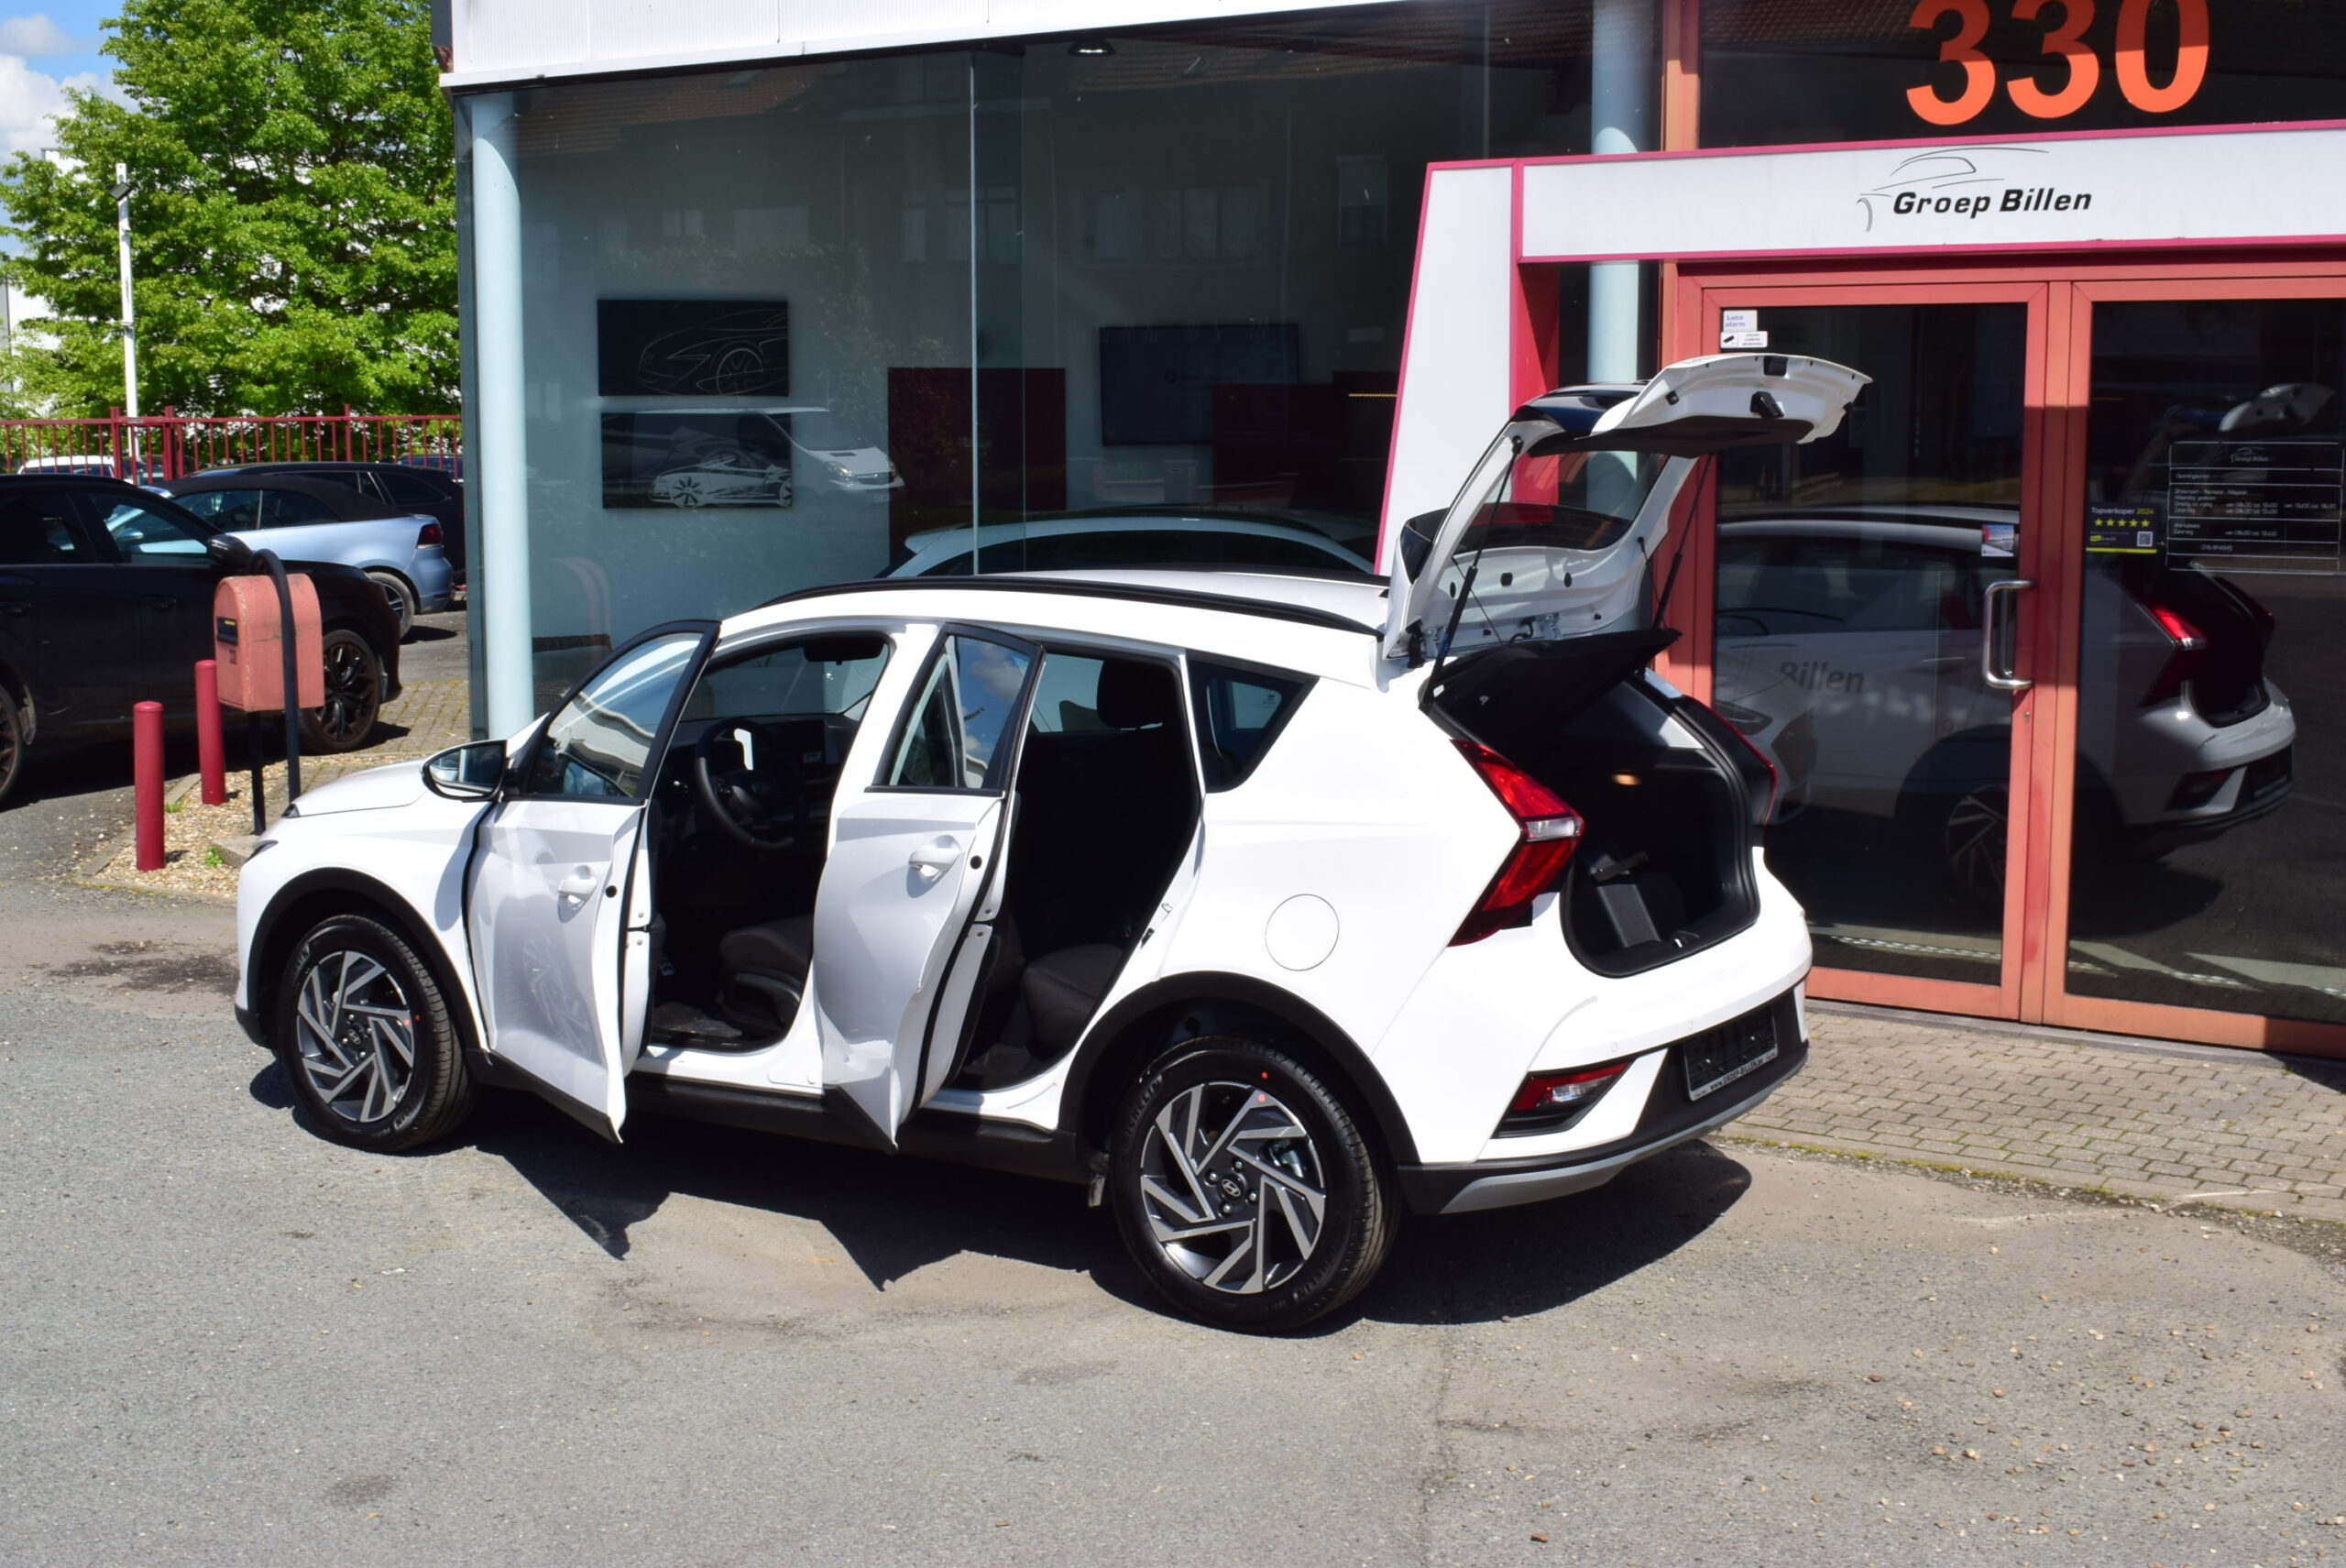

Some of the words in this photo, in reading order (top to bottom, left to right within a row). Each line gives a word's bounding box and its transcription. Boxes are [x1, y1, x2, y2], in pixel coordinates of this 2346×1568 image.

[1906, 0, 2209, 126] 330
[1893, 191, 1991, 219] Groep
[2000, 187, 2092, 213] Billen
